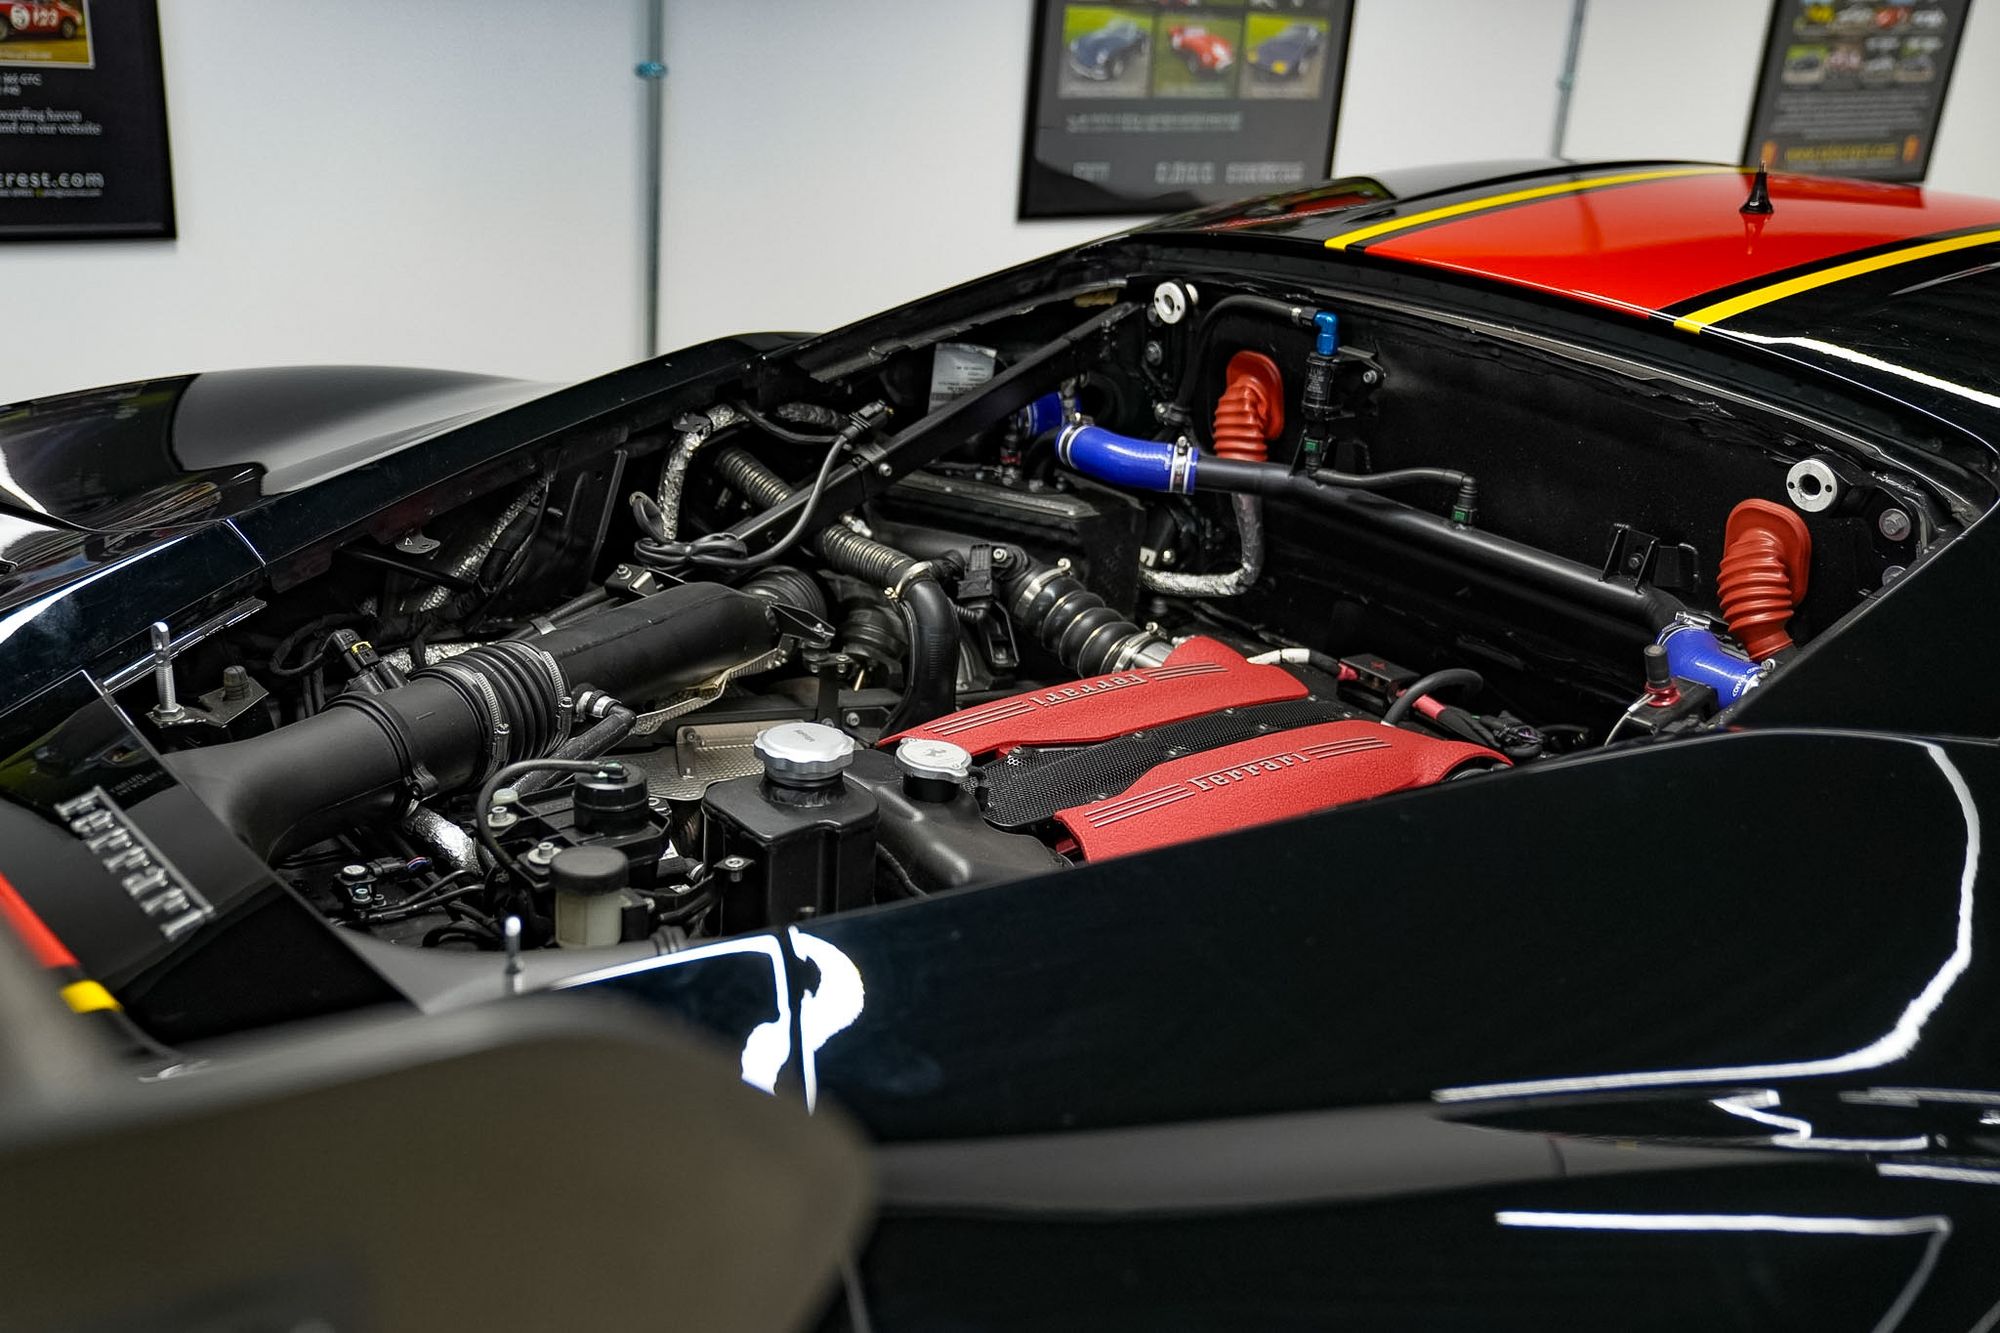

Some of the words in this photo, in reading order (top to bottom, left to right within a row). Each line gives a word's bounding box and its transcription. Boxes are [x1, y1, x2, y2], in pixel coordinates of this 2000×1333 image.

[1029, 673, 1147, 708] Ferrari
[1187, 751, 1310, 791] Ferrari
[55, 785, 214, 940] Ferrari
